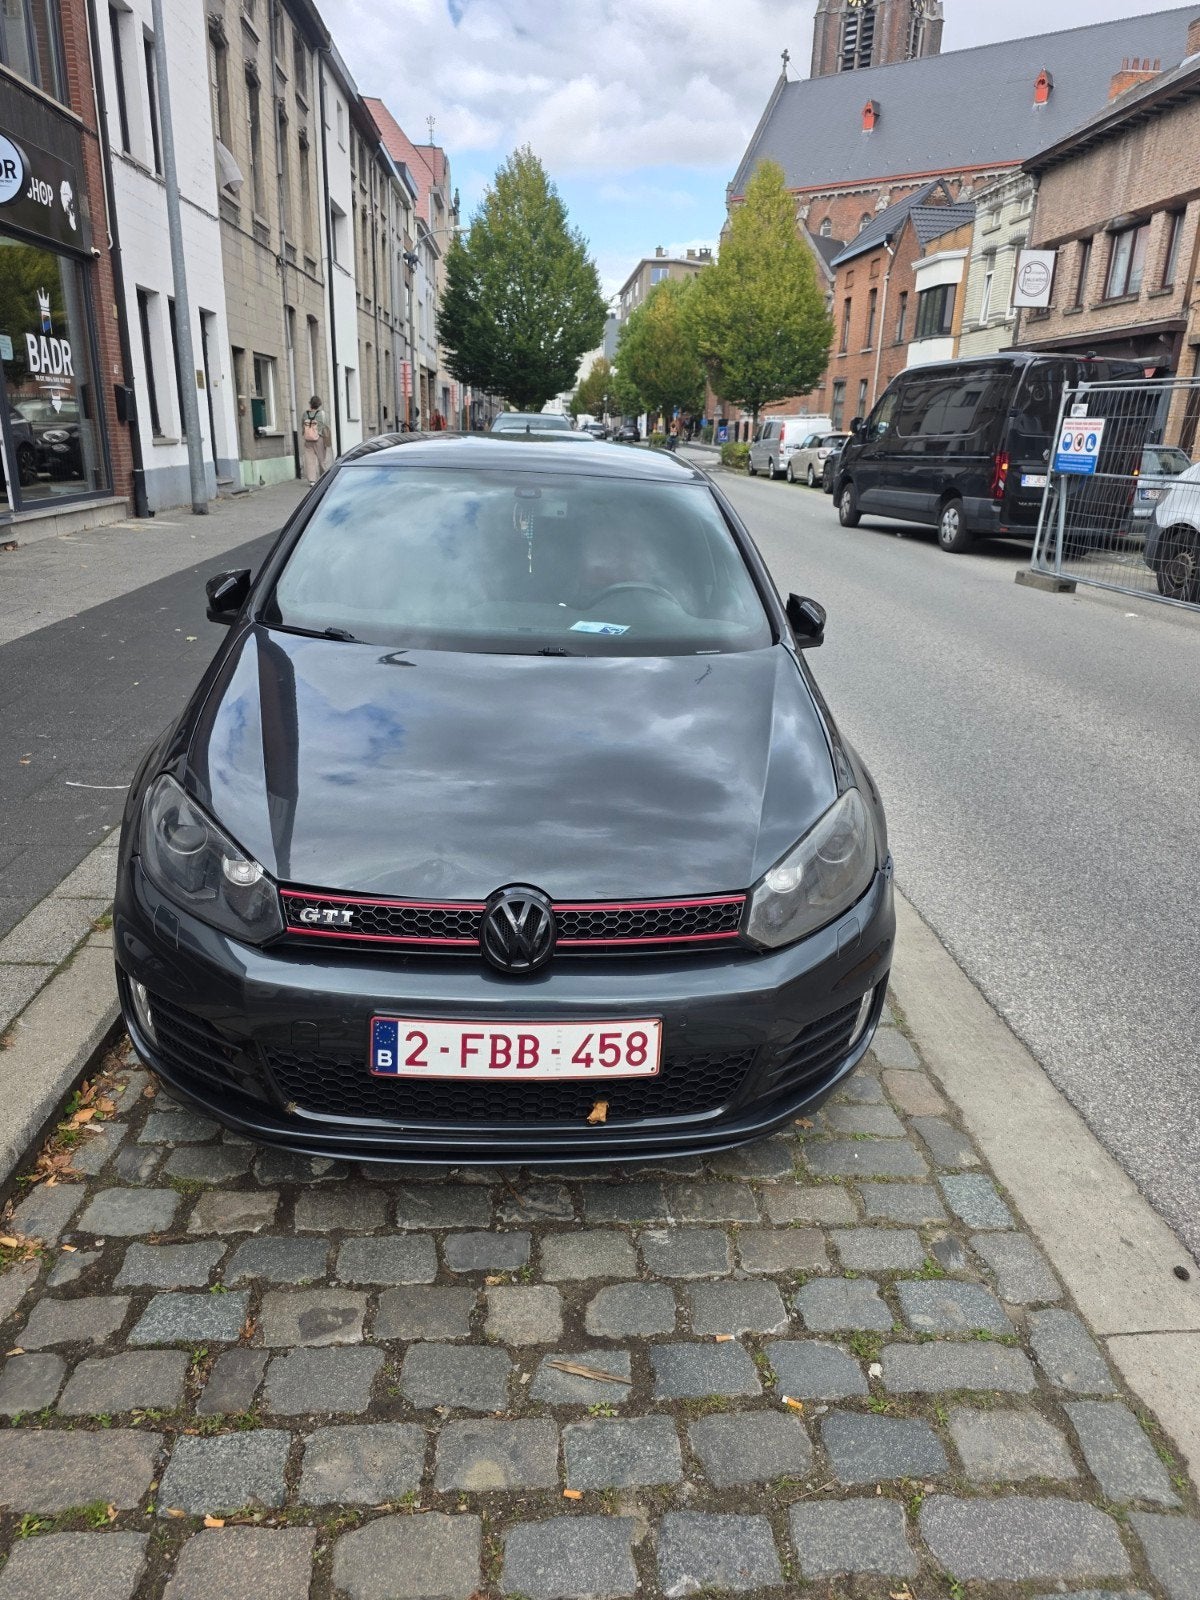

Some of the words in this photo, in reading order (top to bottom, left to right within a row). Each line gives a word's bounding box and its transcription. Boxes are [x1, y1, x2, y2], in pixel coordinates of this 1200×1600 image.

[0, 157, 17, 179] R
[25, 332, 75, 377] BADR
[299, 907, 354, 926] GTI
[376, 1049, 393, 1067] B
[404, 1029, 649, 1069] 2-FBB-458
